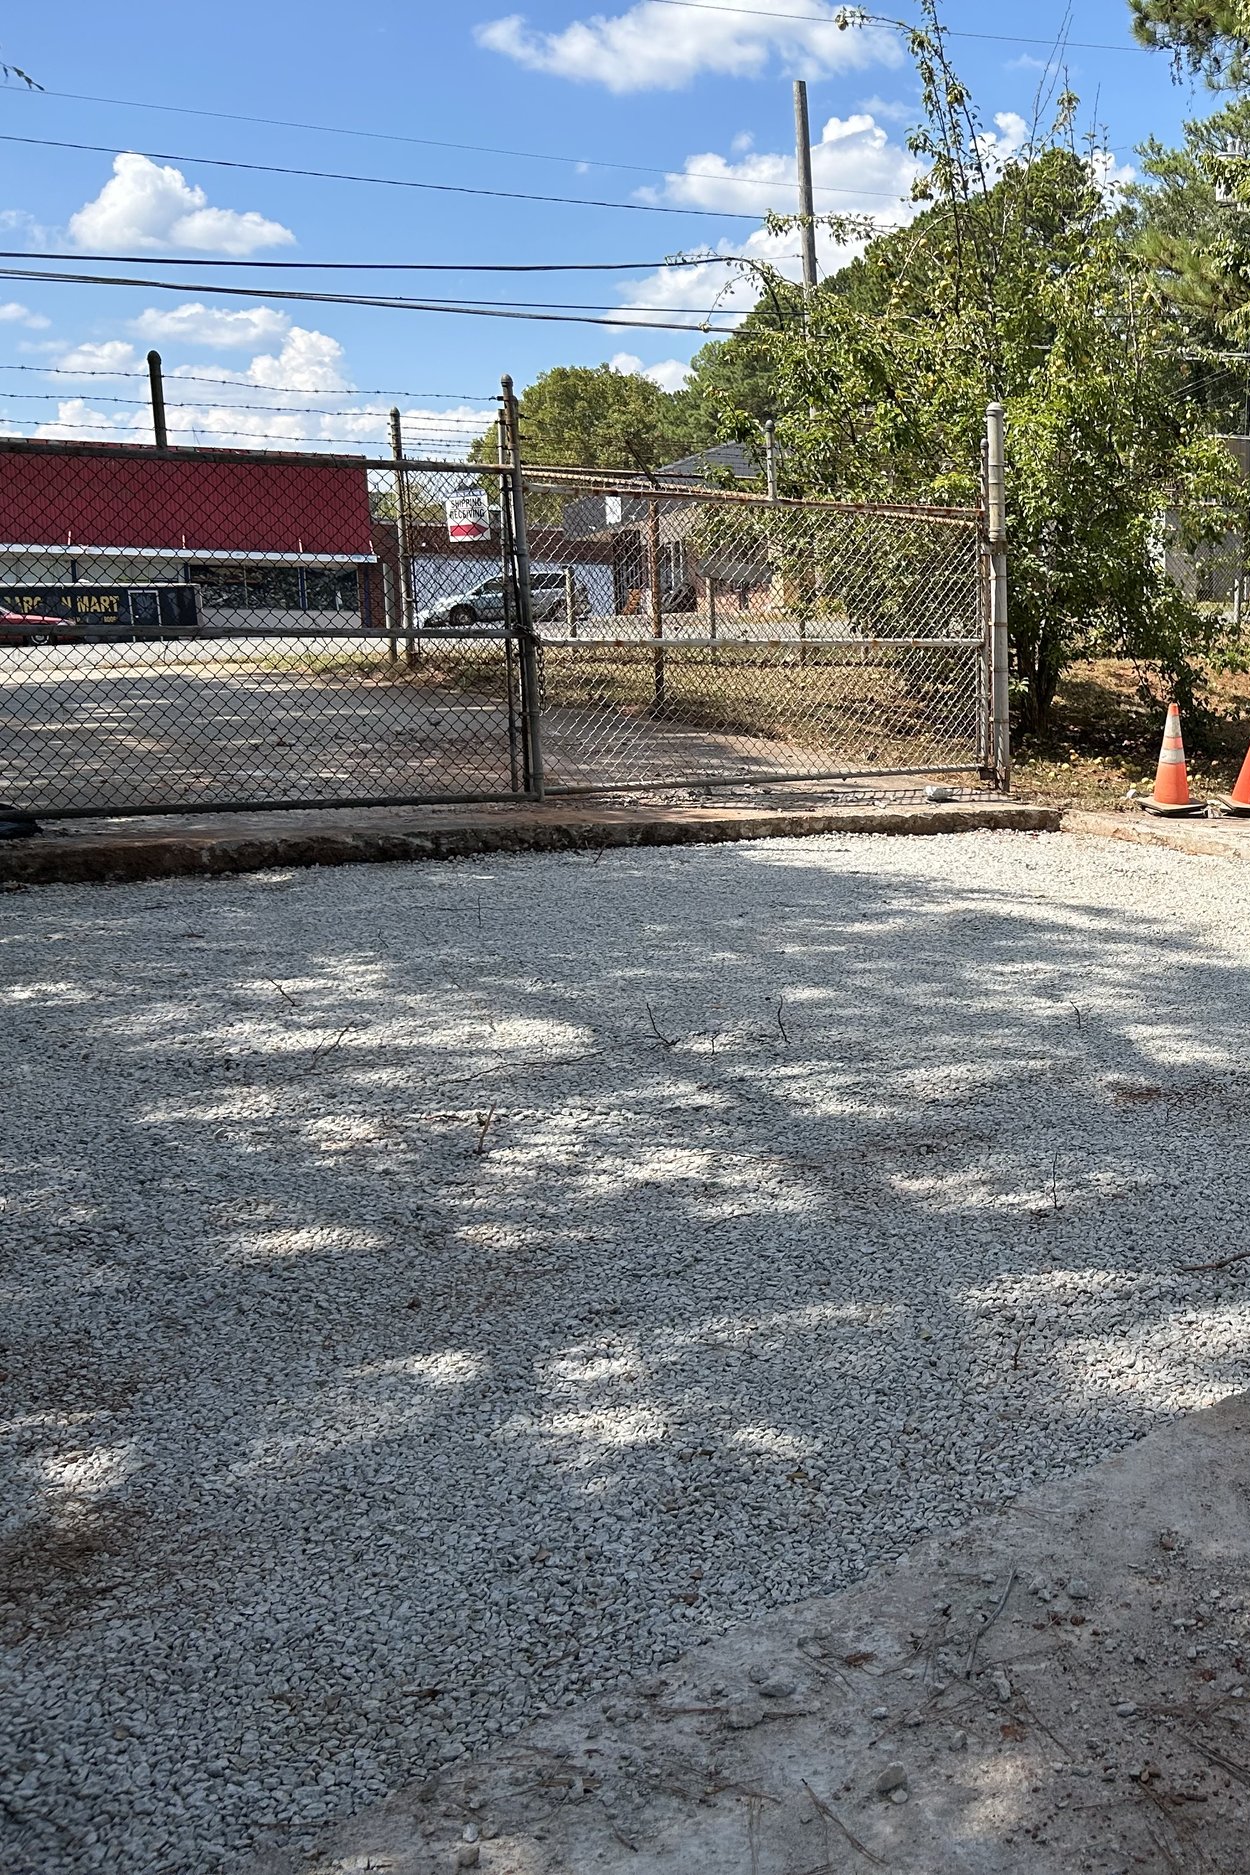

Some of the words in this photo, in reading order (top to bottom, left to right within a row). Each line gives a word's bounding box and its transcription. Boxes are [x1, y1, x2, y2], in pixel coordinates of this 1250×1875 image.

[451, 498, 482, 508] SHIPPING
[449, 508, 484, 519] RECEIVING
[3, 596, 72, 613] ARGN
[76, 595, 119, 612] MART
